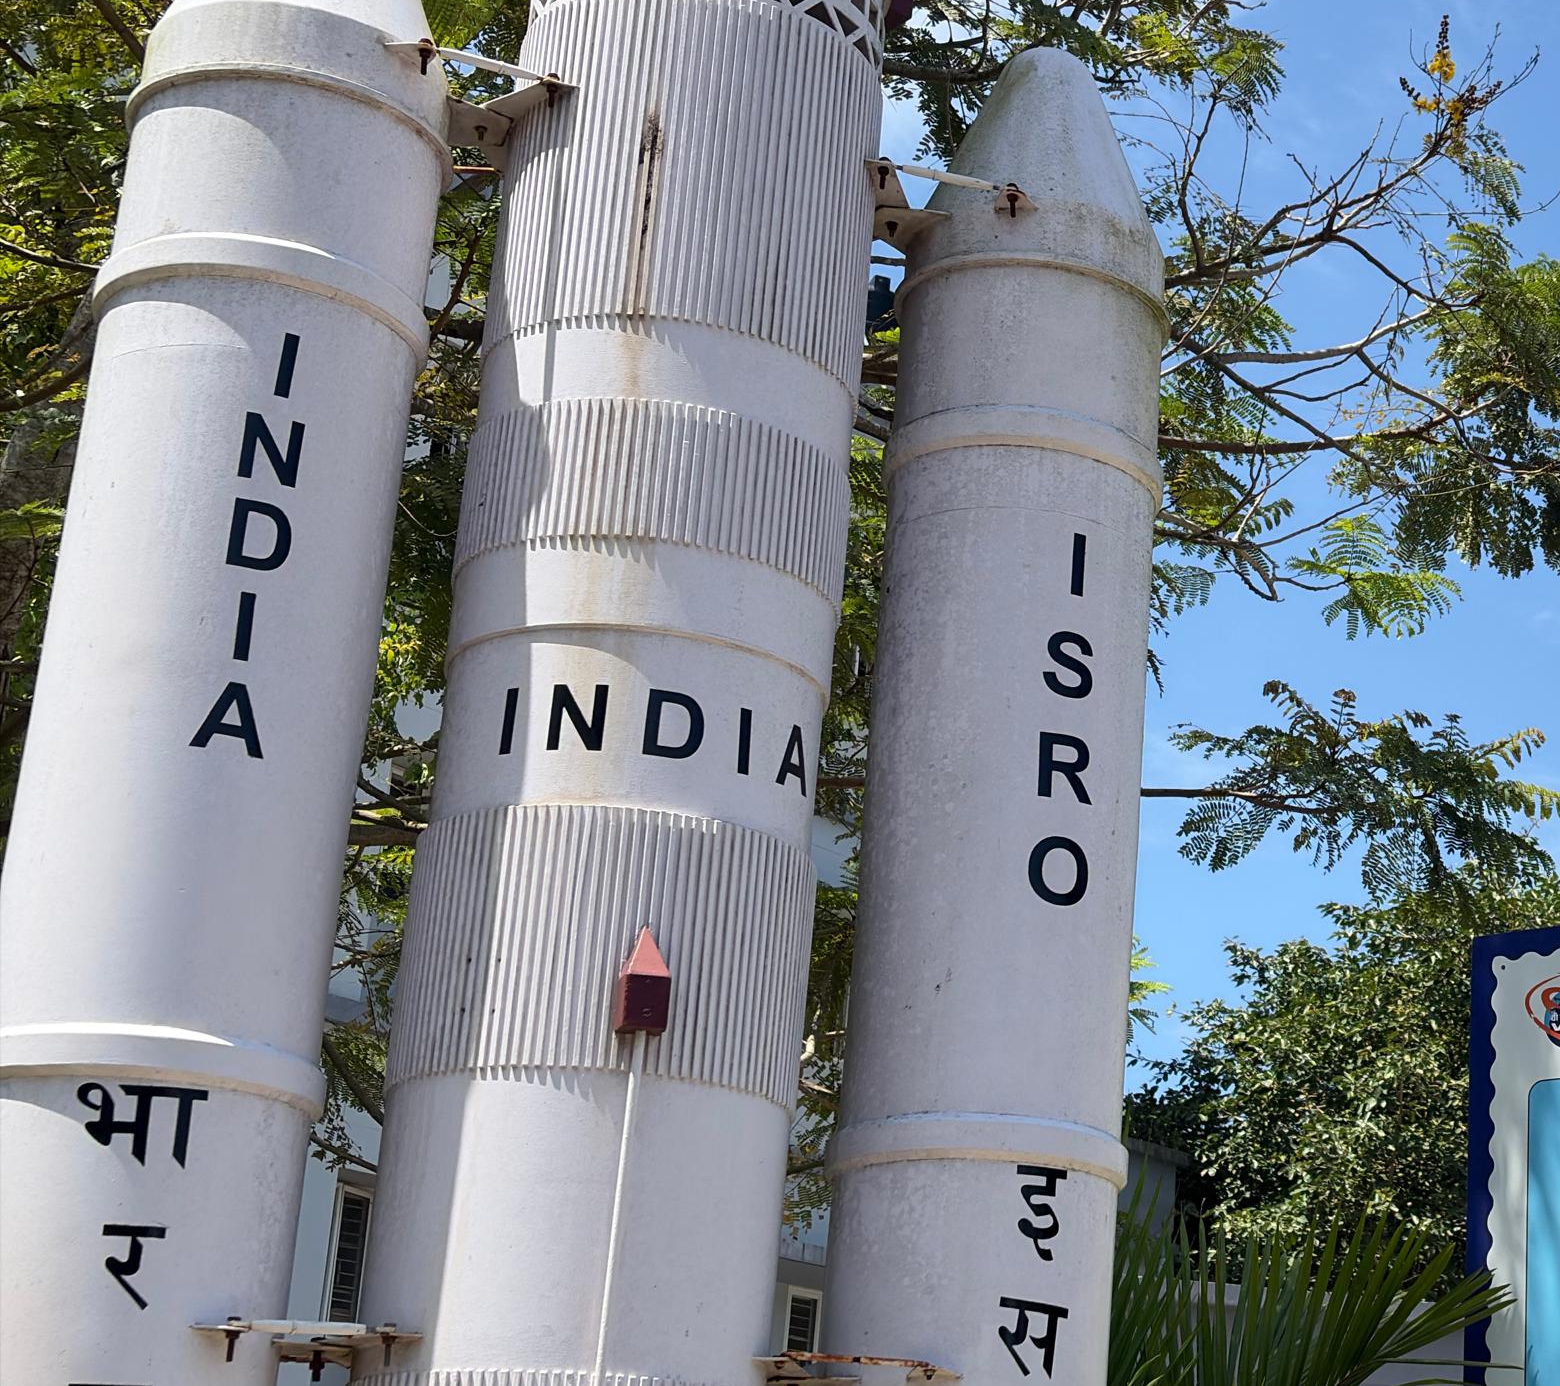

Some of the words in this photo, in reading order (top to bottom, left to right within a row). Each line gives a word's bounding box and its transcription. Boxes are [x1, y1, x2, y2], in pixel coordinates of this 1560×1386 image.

[188, 332, 306, 760] INDIA
[1028, 532, 1094, 907] ISRO
[498, 683, 808, 798] INDIA
